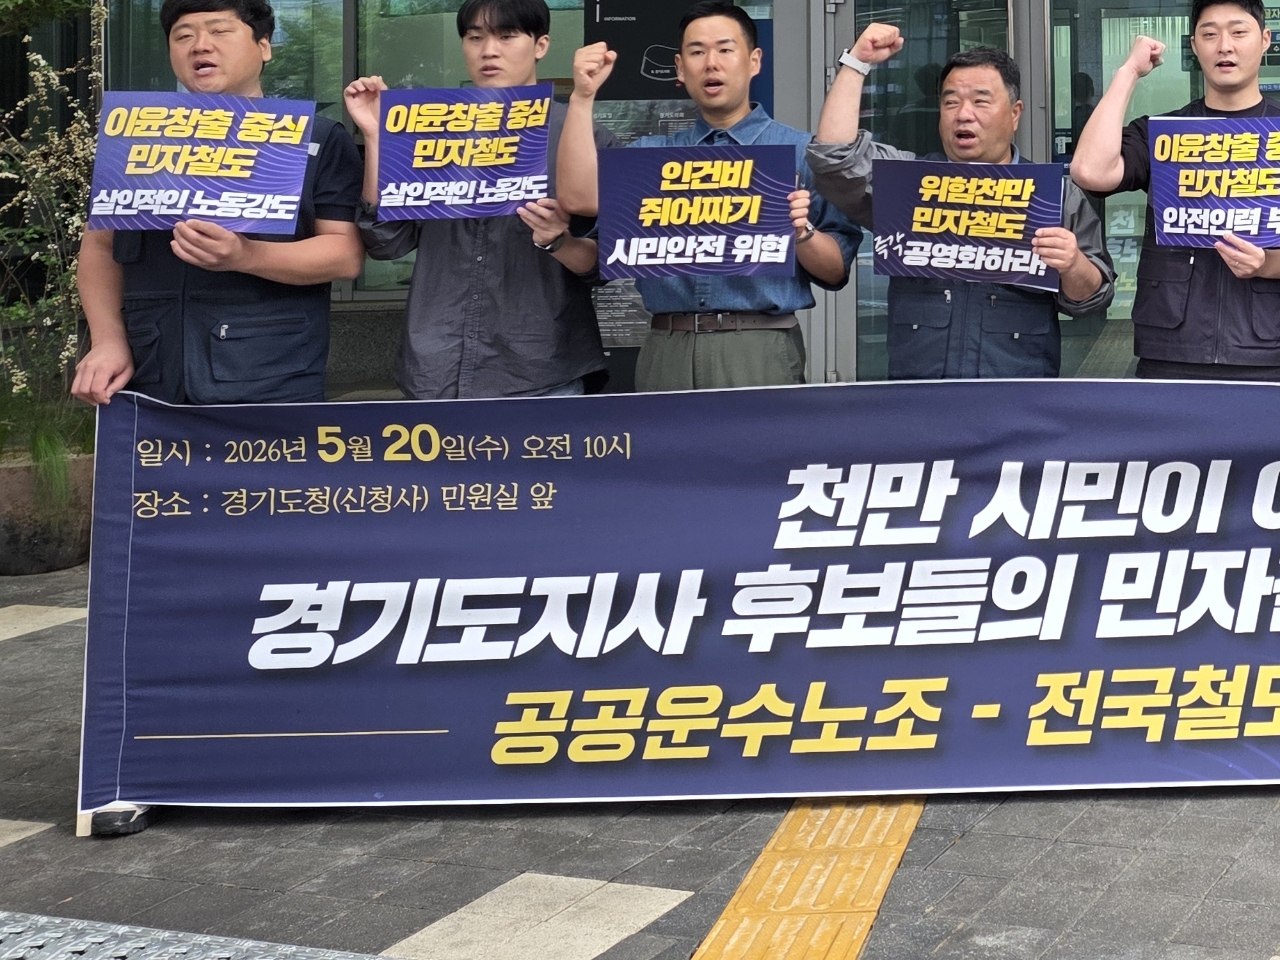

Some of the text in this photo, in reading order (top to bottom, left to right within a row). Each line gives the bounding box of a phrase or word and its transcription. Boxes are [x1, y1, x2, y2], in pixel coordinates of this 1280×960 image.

[104, 106, 310, 145] 이윤창출 중심
[385, 97, 551, 134] 이윤창출 중심
[125, 144, 258, 178] 민자철도
[412, 136, 520, 169] 민자철도
[1153, 132, 1260, 163] 이윤창출
[380, 175, 549, 208] 살인적인 노동강도
[659, 159, 753, 192] 인건비
[918, 175, 1036, 208] 위험천만
[91, 189, 300, 221] 살인적인 노동강도
[638, 194, 762, 228] 쥐어짜기
[1162, 207, 1261, 236] 안전인력
[911, 207, 1028, 240] 민자철도
[606, 234, 790, 266] 시민안전 위협
[874, 232, 905, 259] 즉각
[902, 241, 1047, 276] 공영화하라!
[137, 439, 191, 467] 일시
[224, 437, 307, 464] 2026년
[316, 425, 373, 463] 5월
[381, 422, 509, 462] 20일(수)
[521, 435, 572, 461] 오전
[583, 432, 632, 460] 10시
[133, 489, 191, 518] 장소
[220, 484, 429, 516] 경기도청(신청사)
[442, 483, 519, 511] 민원실
[529, 481, 557, 511] 앞
[773, 460, 958, 550] 천만
[969, 460, 1231, 541] 시민이
[247, 568, 707, 670] 경기도지사
[722, 555, 1078, 653] 후보들의
[490, 676, 948, 765] 공공운수노조
